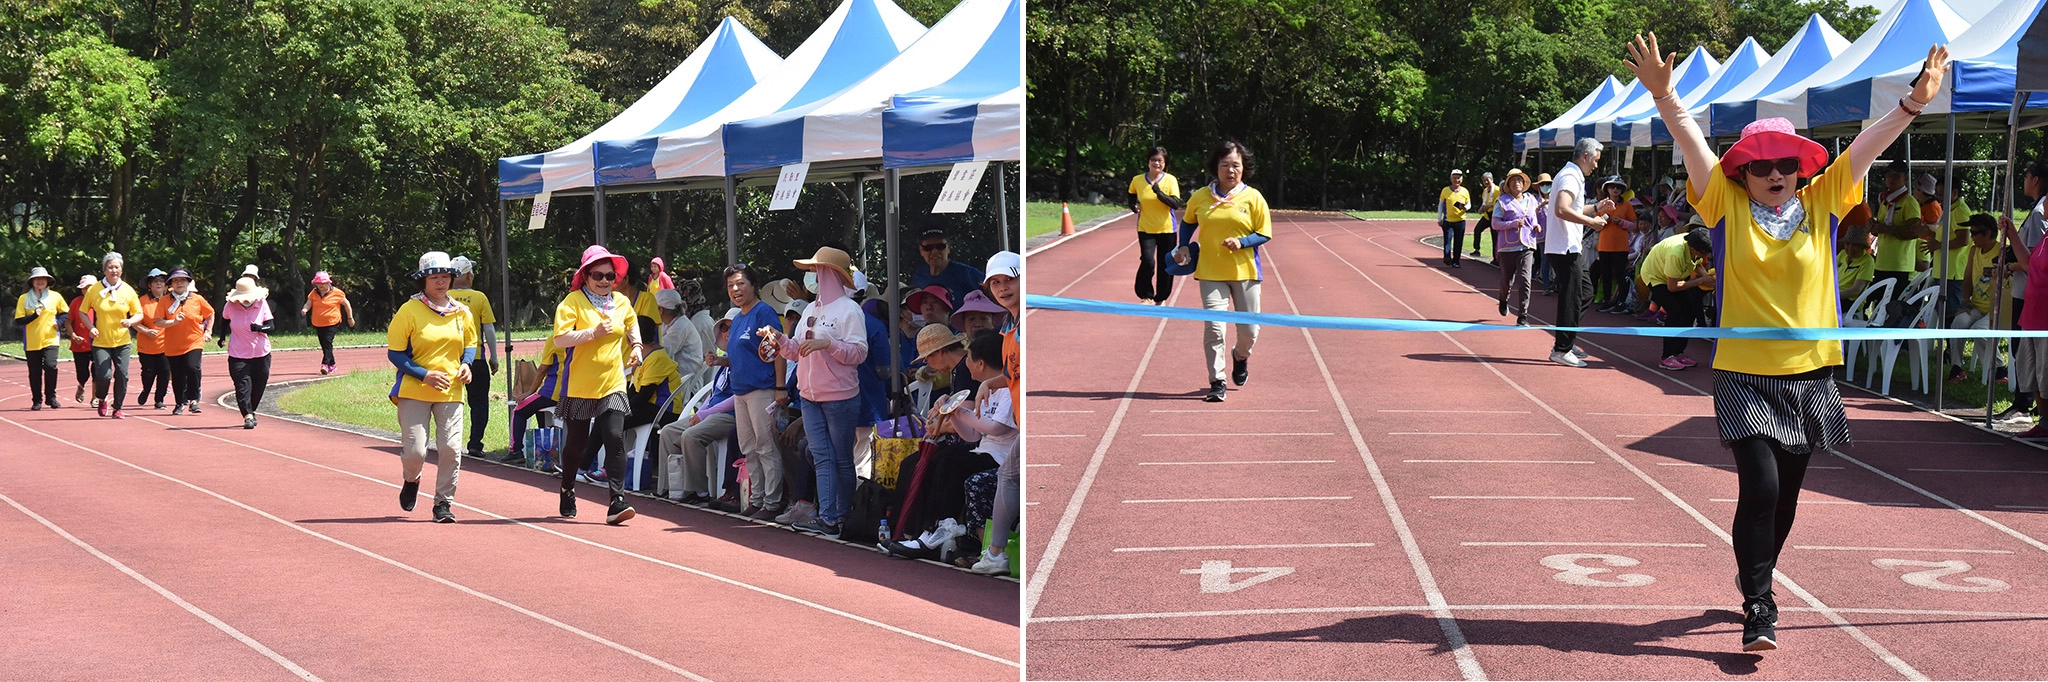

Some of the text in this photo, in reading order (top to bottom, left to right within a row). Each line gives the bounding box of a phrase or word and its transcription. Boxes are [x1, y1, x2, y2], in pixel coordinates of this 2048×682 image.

[1180, 560, 1296, 593] 4
[1539, 553, 1656, 587] 3
[1871, 558, 2012, 593] 2
